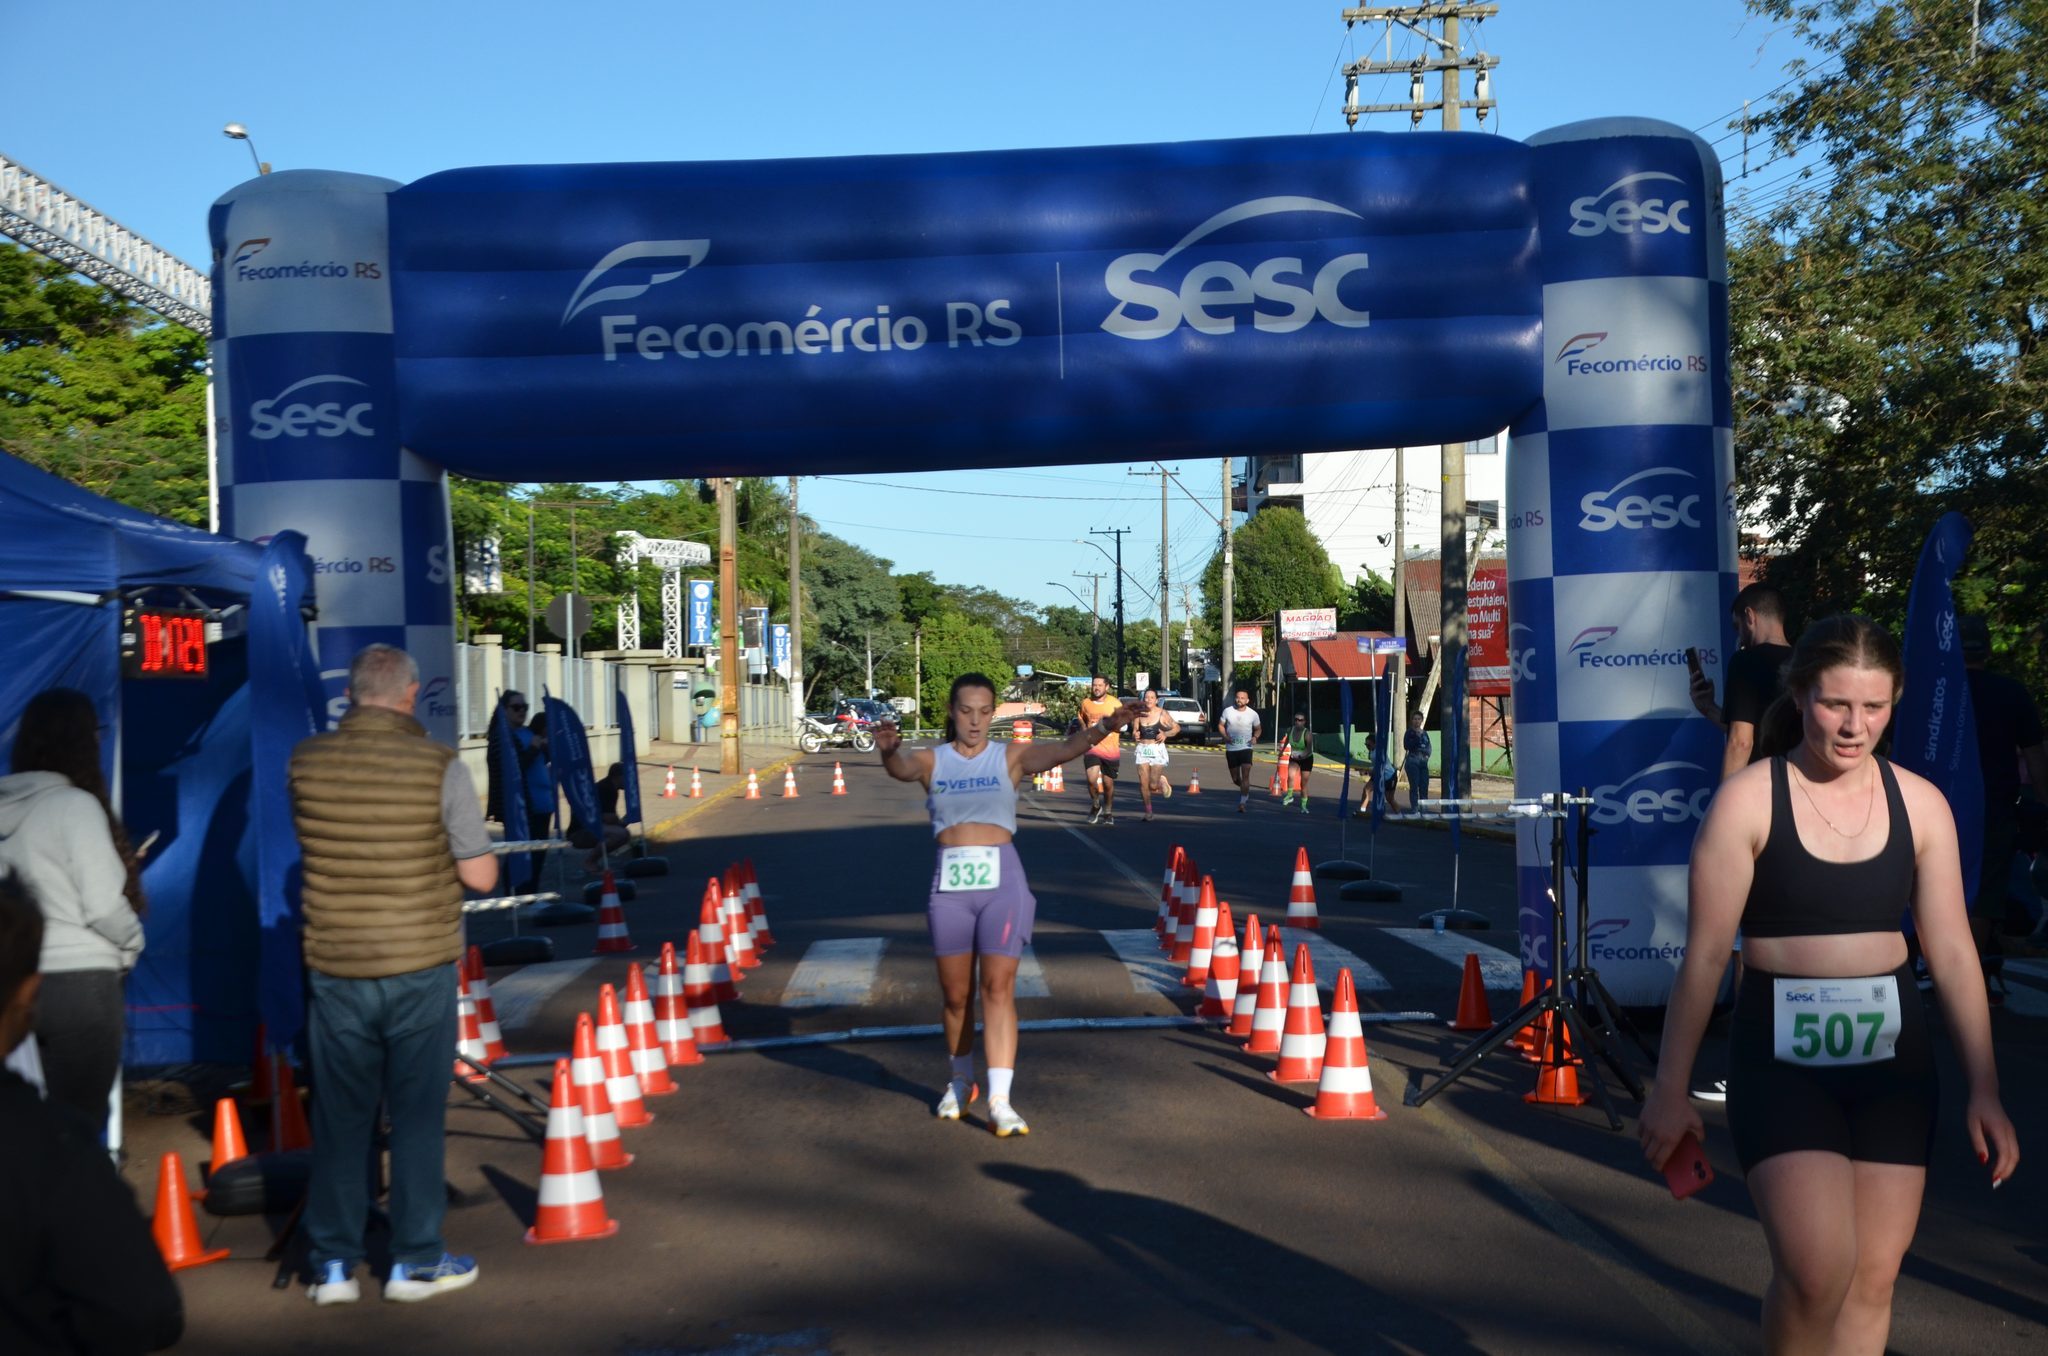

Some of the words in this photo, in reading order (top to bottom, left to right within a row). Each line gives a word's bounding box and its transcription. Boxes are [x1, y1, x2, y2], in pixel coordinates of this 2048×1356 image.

[1568, 195, 1691, 237] Sesc
[238, 260, 349, 281] Fecomércio
[354, 262, 381, 279] RS
[1100, 252, 1370, 340] Sesc
[601, 305, 928, 361] Fecomércio
[946, 299, 1022, 349] RS
[1568, 354, 1682, 375] Fecomércio
[1687, 355, 1707, 372] RS
[249, 399, 375, 439] Sesc
[1525, 510, 1544, 527] RS
[1578, 490, 1700, 532] Sesc
[314, 557, 363, 574] ércio
[369, 557, 396, 574] RS
[1467, 593, 1507, 609] estphalen,
[695, 601, 709, 643] URI
[1480, 609, 1501, 622] Multi
[1468, 643, 1484, 656] ade.
[1699, 648, 1718, 665] RS
[1512, 646, 1536, 682] sc
[1924, 676, 1946, 762] Sindicatos
[950, 776, 1001, 790] VETRIA
[948, 862, 992, 887] 332
[1521, 934, 1548, 969] sc
[1786, 991, 1815, 1002] Sesc
[1791, 1012, 1885, 1059] 507
